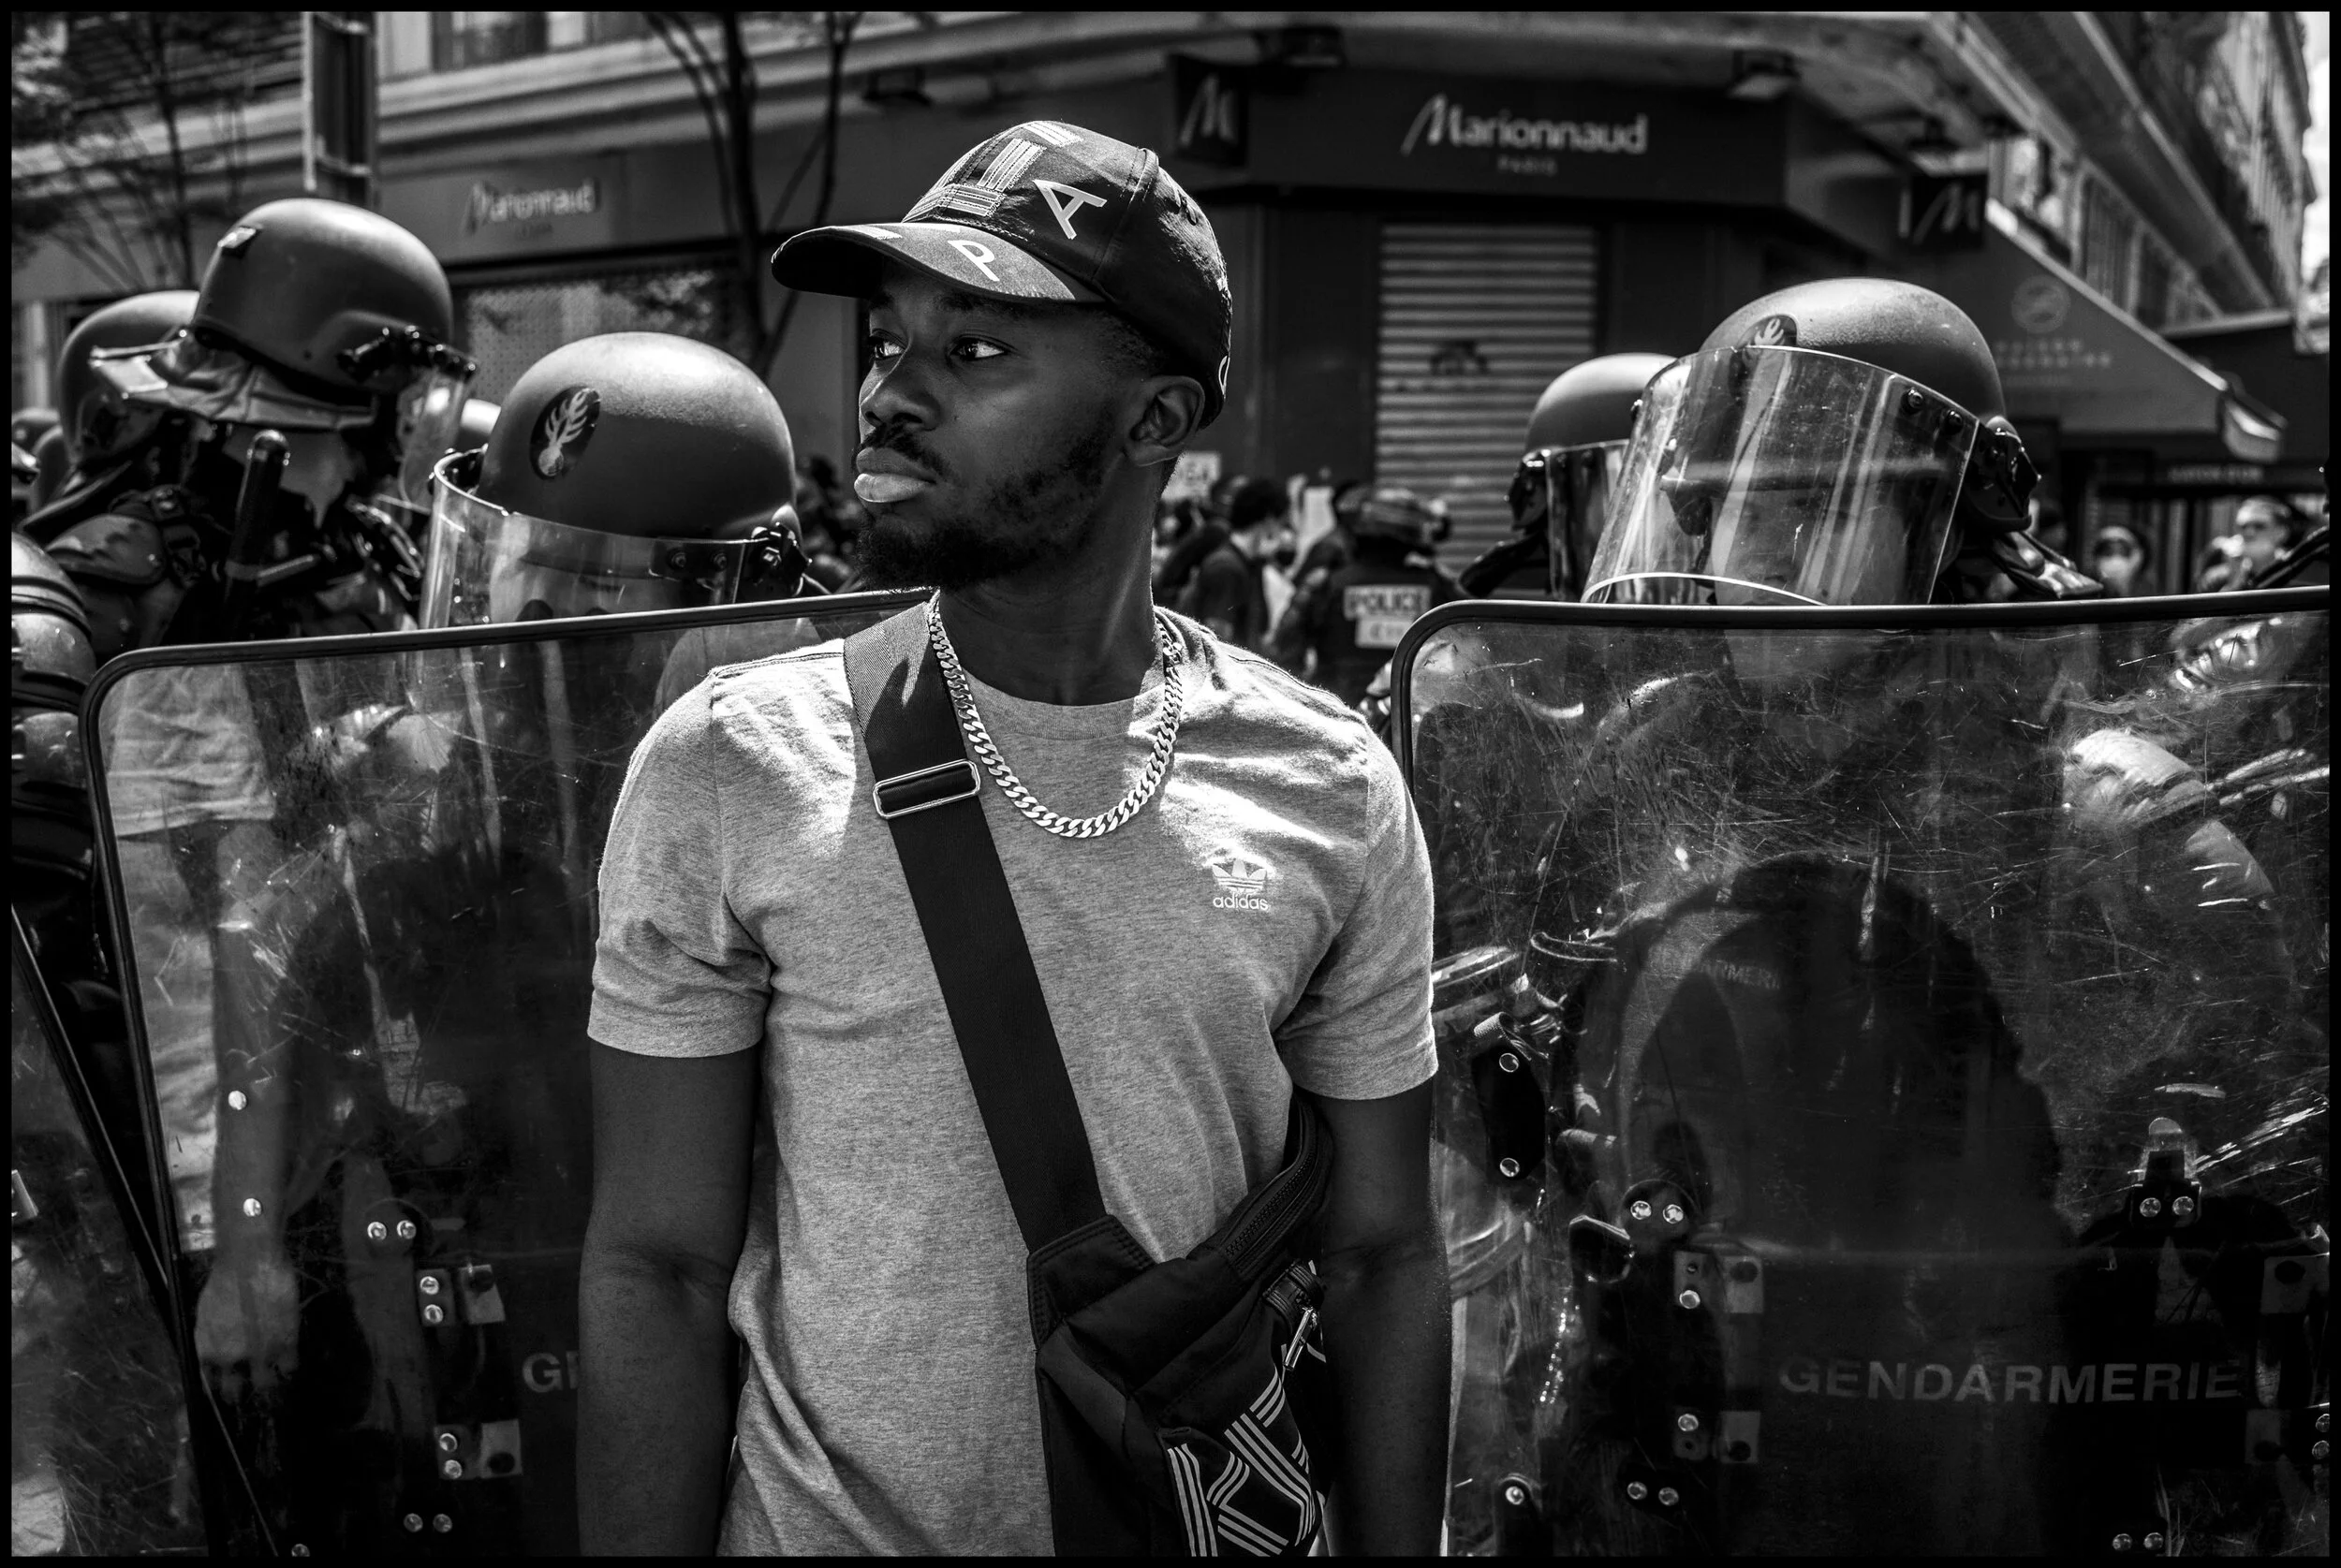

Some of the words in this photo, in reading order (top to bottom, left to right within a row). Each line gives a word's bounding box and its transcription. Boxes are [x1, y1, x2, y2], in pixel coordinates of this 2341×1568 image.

[1401, 93, 1647, 156] Marionnaud
[1032, 179, 1108, 240] A
[947, 239, 1001, 282] P
[1212, 891, 1270, 912] adidas
[1778, 1355, 2243, 1405] GENDARMERIE
